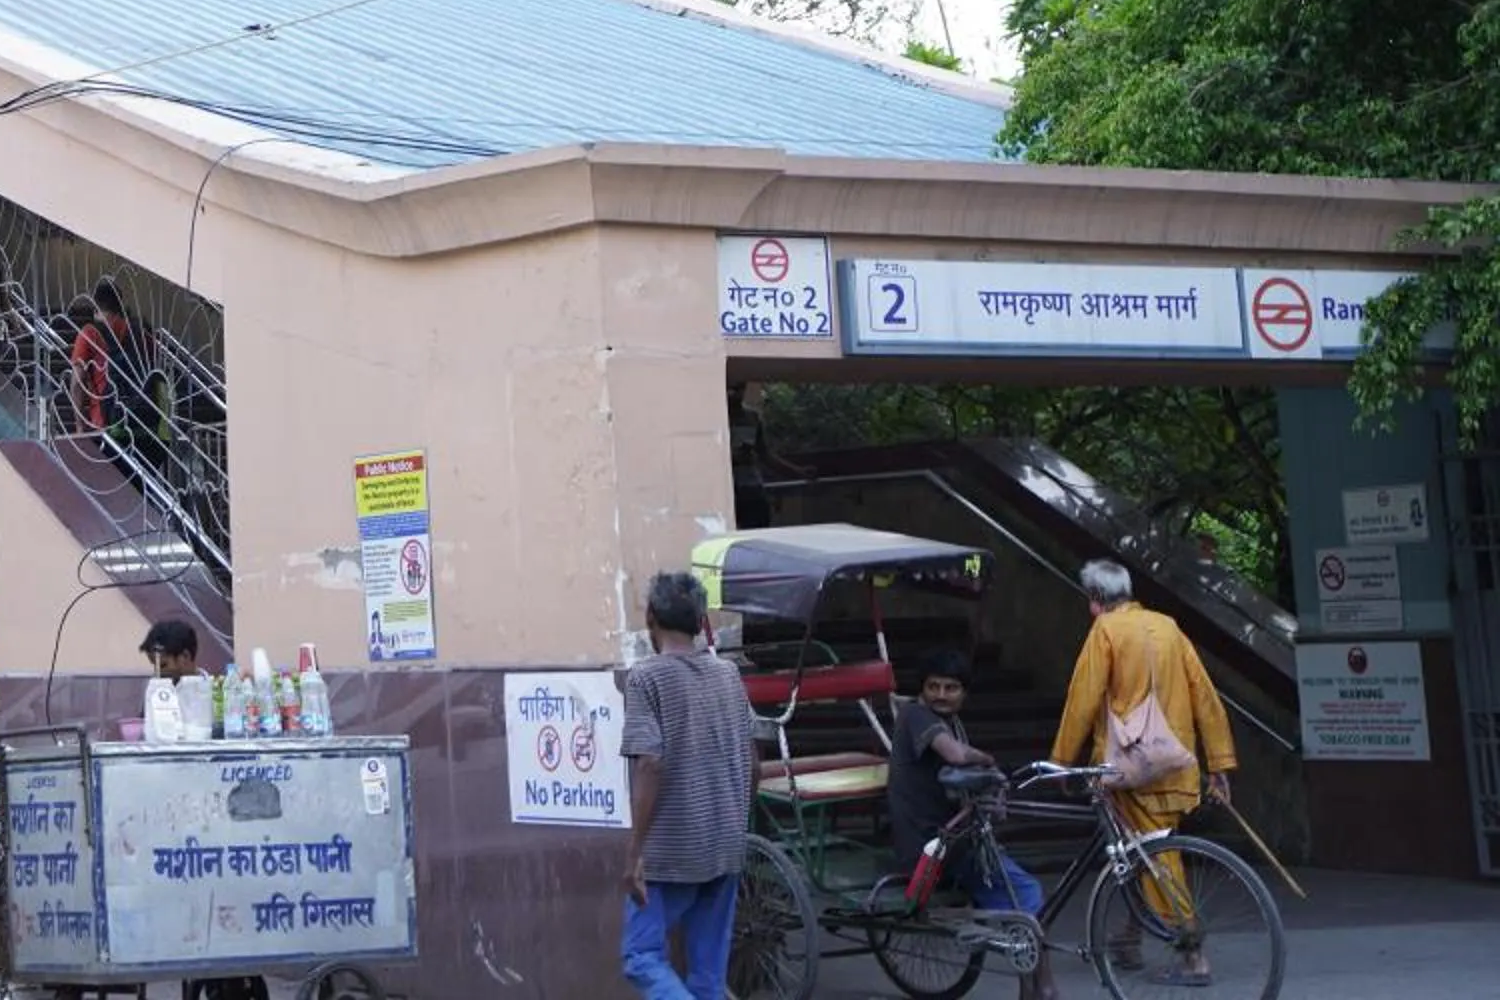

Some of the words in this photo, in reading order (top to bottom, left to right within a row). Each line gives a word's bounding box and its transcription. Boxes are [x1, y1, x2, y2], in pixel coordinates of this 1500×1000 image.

[727, 277, 758, 309] गेट
[803, 286, 818, 309] 2
[881, 283, 907, 325] 2
[977, 291, 1073, 325] रामकृष्ण
[1080, 292, 1148, 320] आश्रम
[1154, 287, 1198, 321] मार्ग
[721, 310, 773, 333] Gate
[779, 311, 809, 333] No
[815, 312, 829, 333] 2
[525, 780, 549, 806] No
[552, 782, 615, 815] Parking
[53, 801, 77, 834] का
[41, 840, 79, 887] पानी
[152, 836, 225, 883] मशीन
[227, 845, 258, 877] का
[260, 835, 301, 876] ठंडा
[303, 833, 353, 874] पानी
[251, 891, 296, 934] प्रति
[300, 891, 376, 933] गिलास
